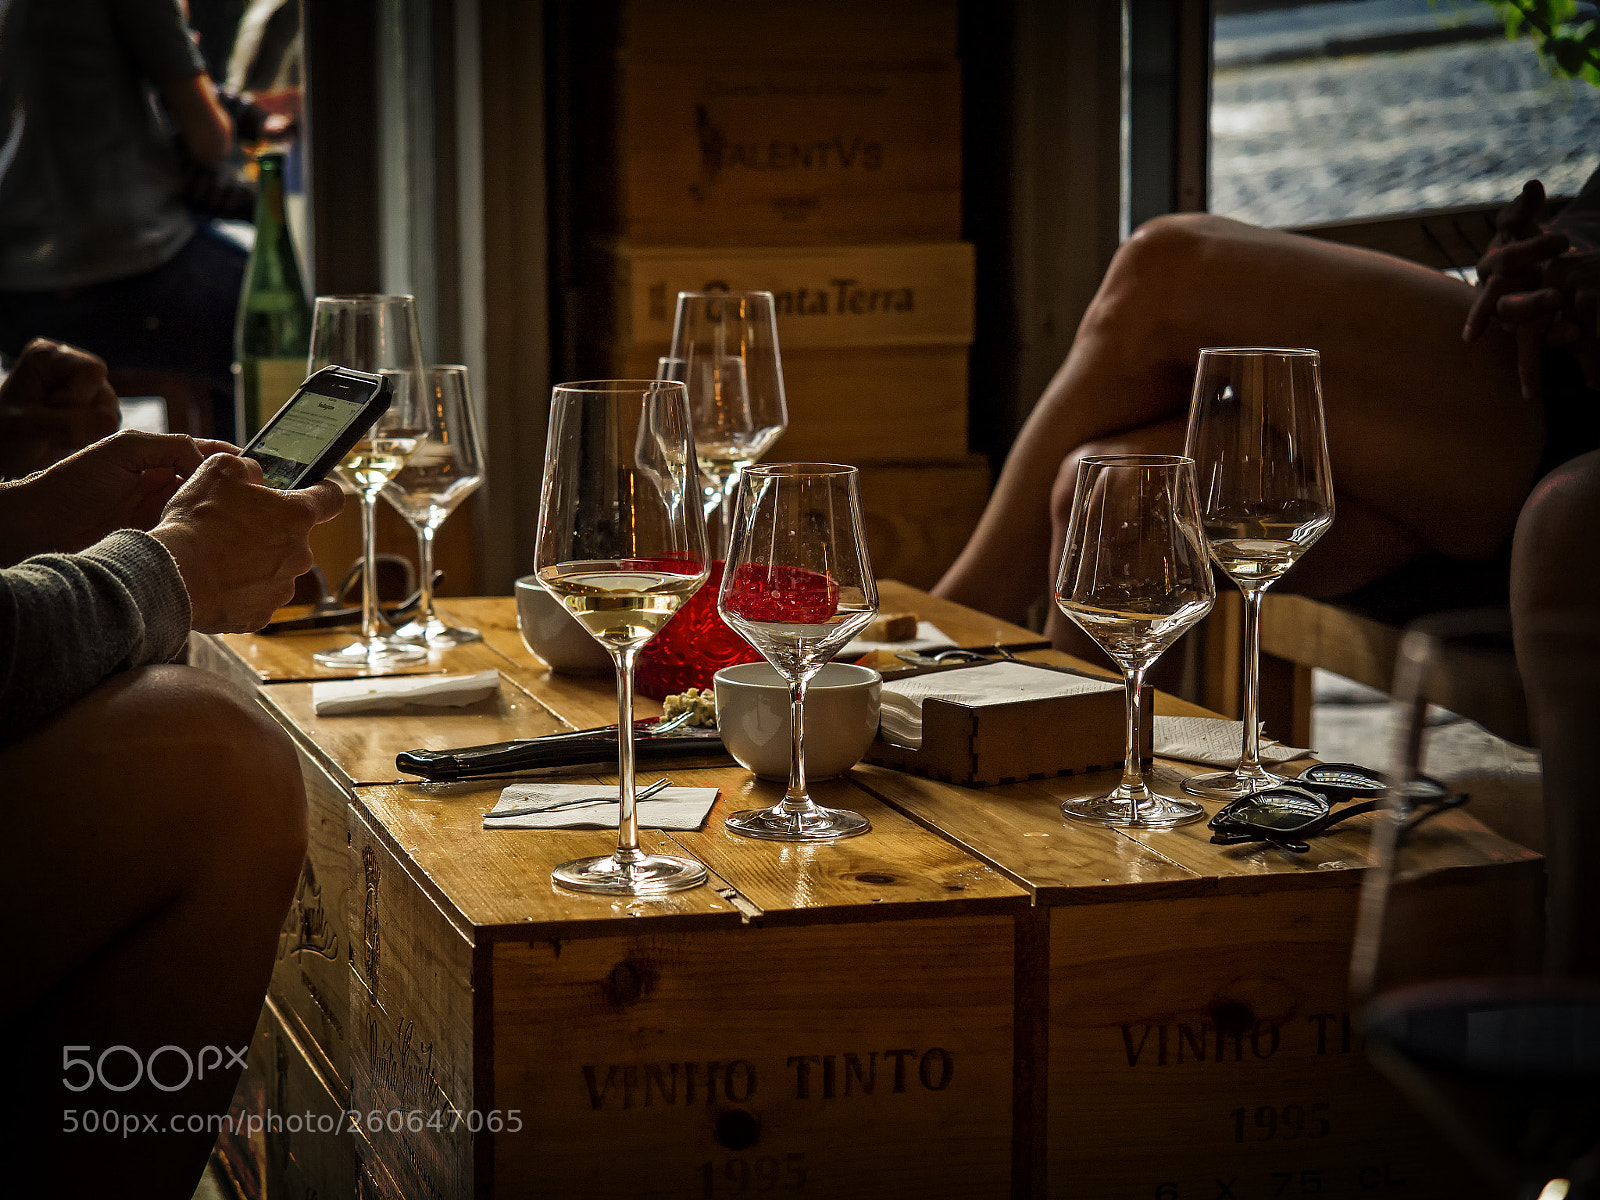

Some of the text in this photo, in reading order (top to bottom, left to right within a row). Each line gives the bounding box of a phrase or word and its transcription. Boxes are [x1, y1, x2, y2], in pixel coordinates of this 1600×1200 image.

[1120, 1017, 1280, 1067] VINHO
[581, 1046, 955, 1111] VINHO TINTO
[1229, 1102, 1331, 1144] 1995
[695, 1152, 808, 1199] 1995
[1271, 1169, 1323, 1197] 75
[1357, 1162, 1407, 1190] CL
